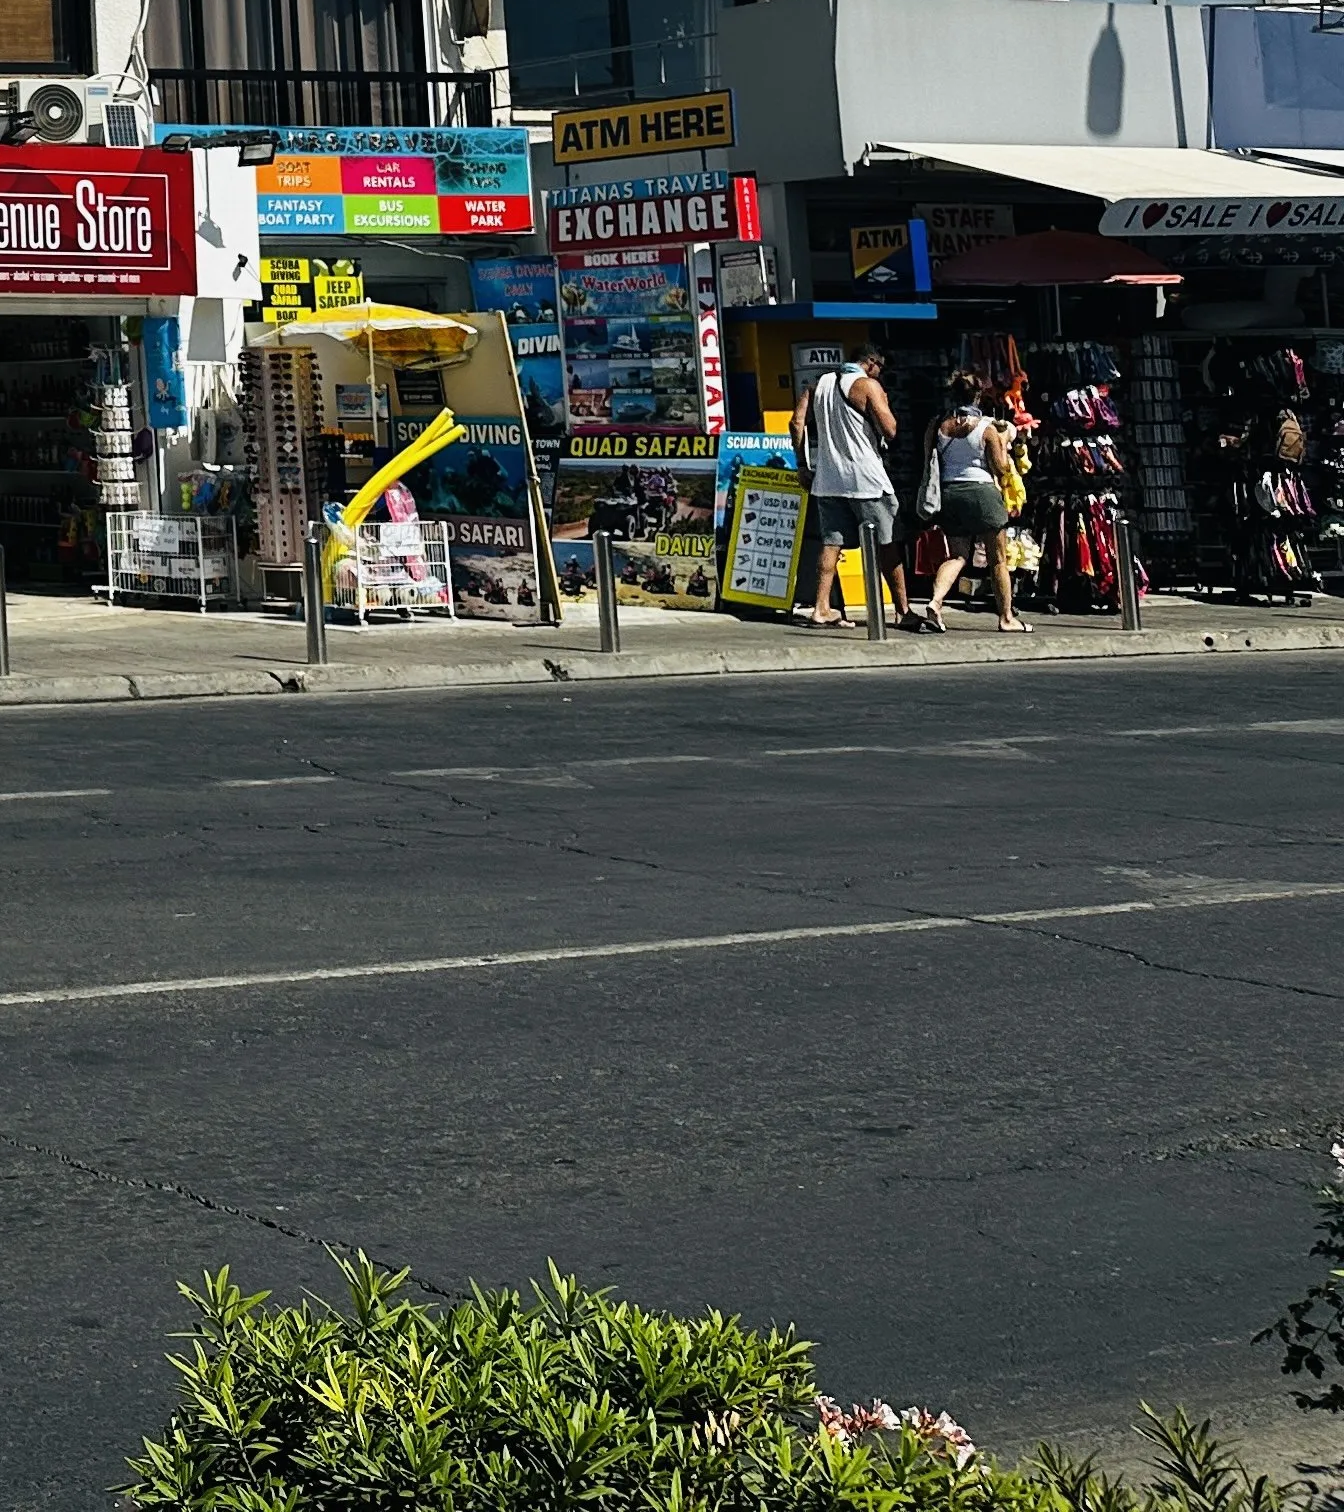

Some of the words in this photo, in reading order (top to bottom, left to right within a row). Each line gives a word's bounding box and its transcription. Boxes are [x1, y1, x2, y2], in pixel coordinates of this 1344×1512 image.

[561, 116, 630, 153] ATM
[641, 104, 725, 143] HERE
[277, 161, 310, 173] BOAT
[376, 162, 401, 173] CAR
[277, 176, 312, 187] TRIPS
[363, 176, 415, 189] RENTALS
[552, 182, 633, 206] TITANAS
[645, 171, 725, 196] TRAVEL
[268, 200, 322, 211] FANTASY
[379, 200, 404, 212] BUS
[465, 201, 506, 213] WATER
[741, 177, 754, 240] PARTIES
[76, 179, 151, 251] Store
[259, 214, 291, 225] BOAT
[296, 213, 334, 226] PARTY
[354, 215, 431, 228] EXCURSIONS
[471, 215, 503, 227] PARK
[558, 194, 729, 241] EXCHANGE
[932, 208, 995, 228] STAFF
[1124, 205, 1140, 228] I
[1165, 204, 1242, 228] SALE
[1248, 204, 1263, 227] I
[855, 227, 904, 249] ATM
[270, 260, 300, 270] SCUBA
[584, 254, 619, 267] BOOK
[622, 251, 660, 265] HERE!
[271, 271, 300, 281] DIVING
[326, 281, 351, 294] JEEP
[271, 295, 302, 306] SAFARI
[276, 311, 298, 320] BOAT
[809, 347, 841, 362] ATM
[460, 424, 521, 445] DIVING
[535, 439, 560, 448] TOWN
[570, 436, 628, 457] QUAD
[634, 436, 715, 456] SAFARI
[727, 436, 761, 449] SCUBA
[764, 497, 780, 507] USD
[760, 516, 777, 527] GBP
[460, 524, 524, 547] SAFARI
[757, 537, 773, 547] CHF
[656, 534, 714, 557] DAILY
